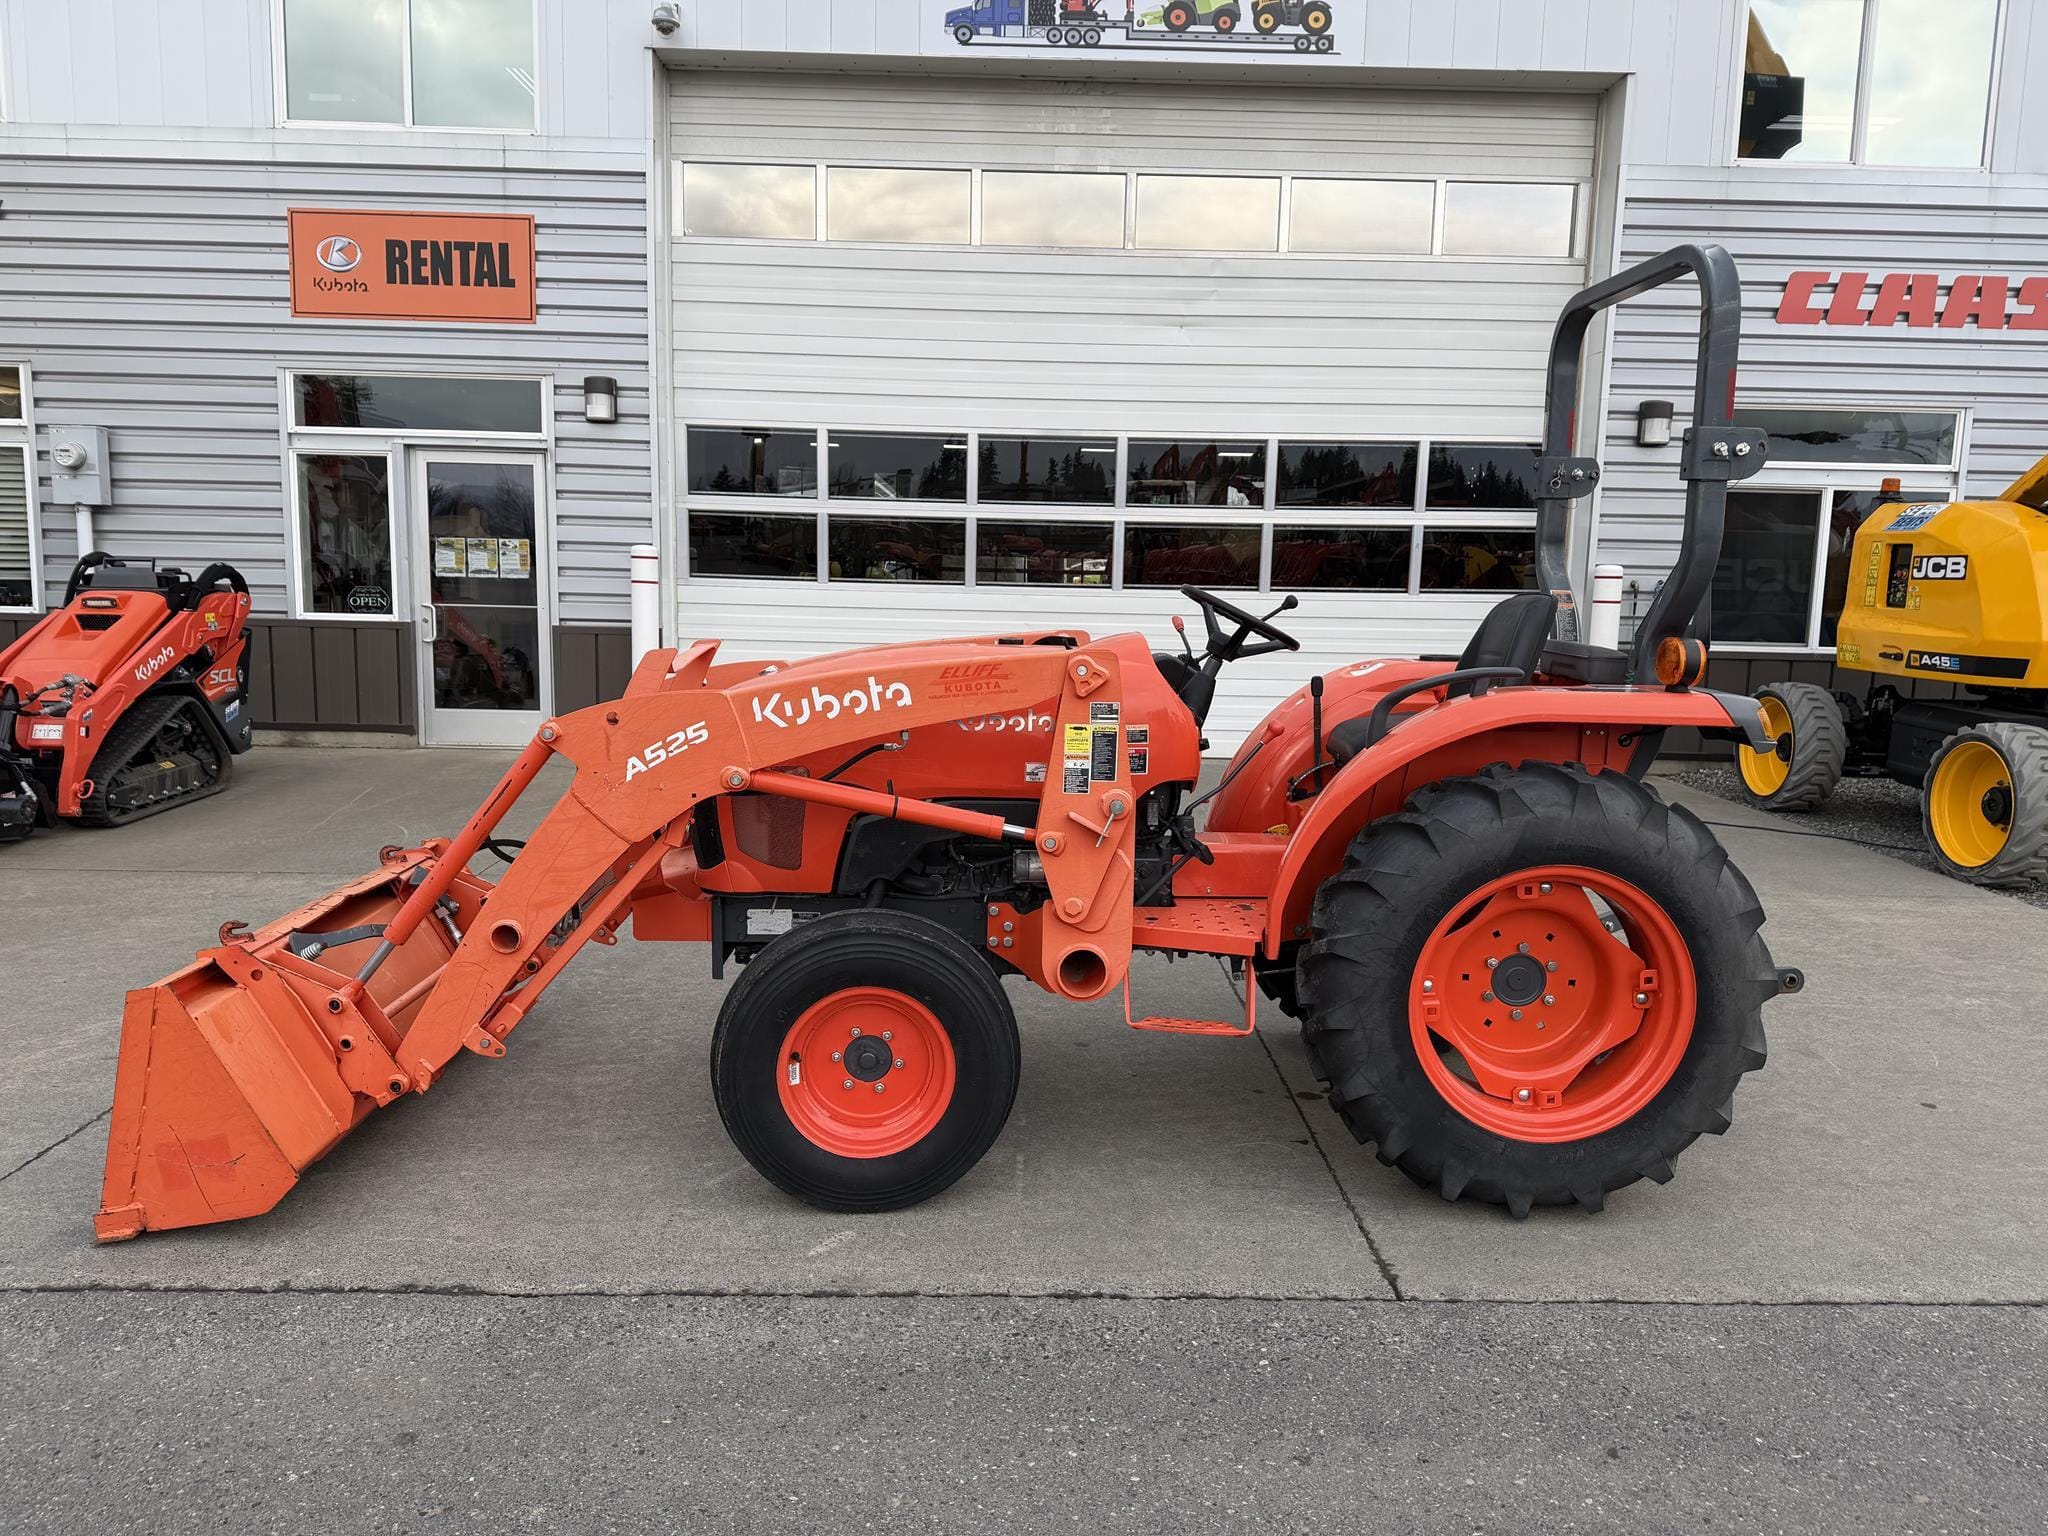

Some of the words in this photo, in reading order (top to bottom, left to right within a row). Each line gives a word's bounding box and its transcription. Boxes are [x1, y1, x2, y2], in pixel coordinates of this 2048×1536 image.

[385, 238, 516, 288] RENTAL
[313, 276, 368, 293] Kubota
[1775, 271, 2048, 330] CLAAS
[1913, 556, 1966, 579] JCB
[350, 596, 387, 607] OPEN
[135, 646, 175, 681] Kubota
[1921, 654, 1960, 668] A45E
[209, 668, 235, 685] SCL
[939, 663, 1003, 680] ELLIFF
[944, 681, 1002, 694] KUBOTA
[752, 676, 913, 728] Kubota
[625, 720, 709, 782] A525
